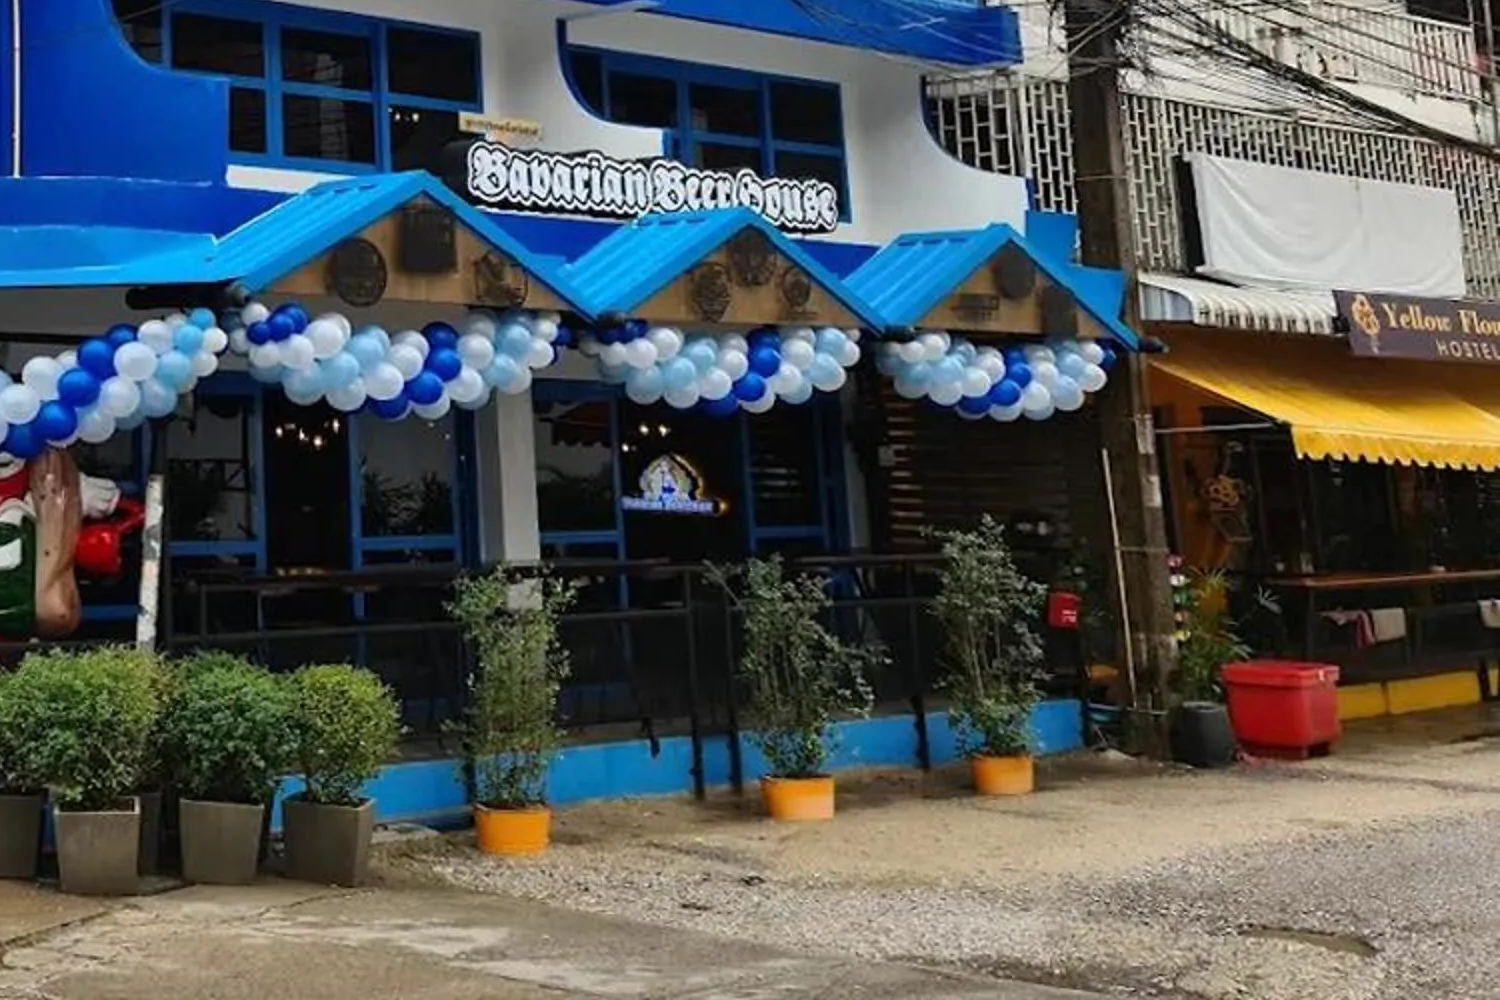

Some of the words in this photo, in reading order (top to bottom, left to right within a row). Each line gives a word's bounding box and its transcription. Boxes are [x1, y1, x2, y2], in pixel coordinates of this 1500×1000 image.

[469, 143, 650, 213] Bavarian
[651, 160, 734, 212] Beer
[736, 169, 836, 229] House
[1381, 302, 1453, 332] Yellow
[1435, 338, 1500, 360] HOSTEL
